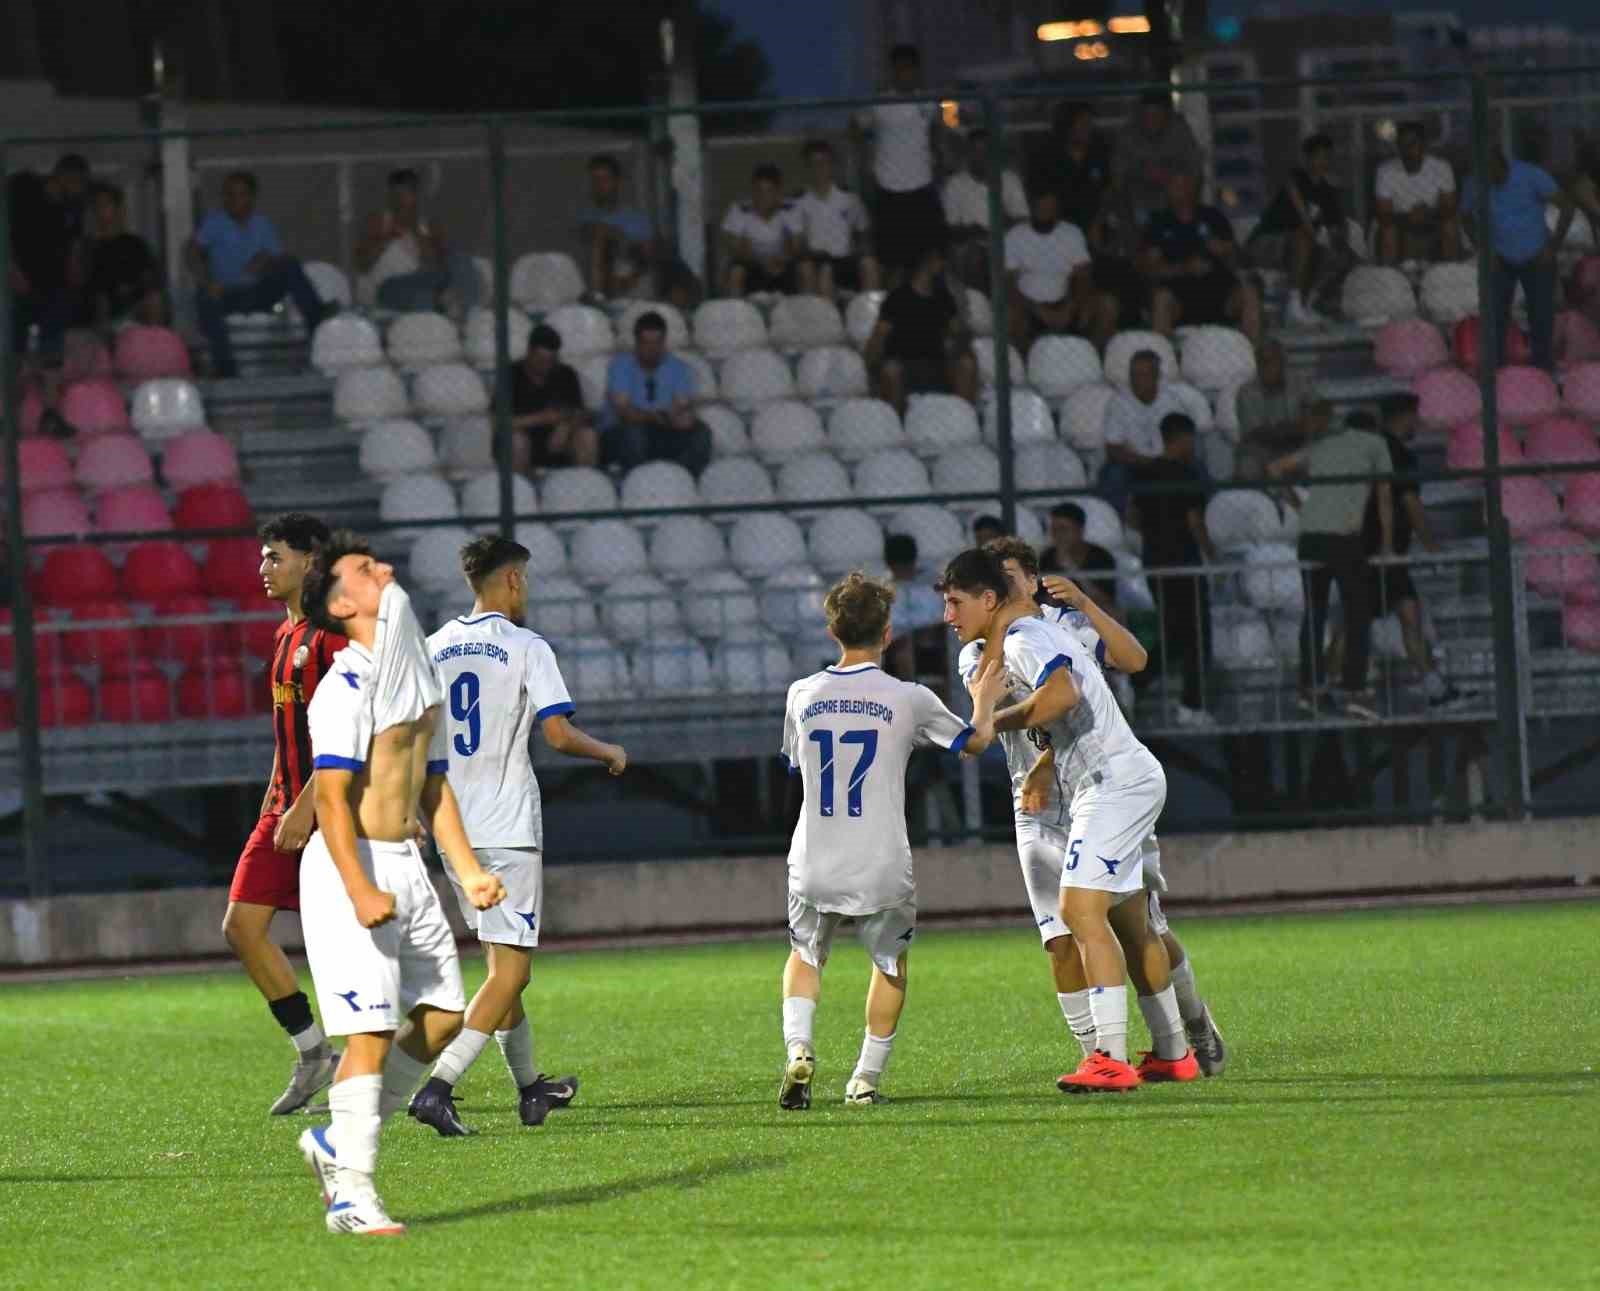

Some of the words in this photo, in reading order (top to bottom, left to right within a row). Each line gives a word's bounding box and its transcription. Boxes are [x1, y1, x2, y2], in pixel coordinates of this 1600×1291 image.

[450, 671, 481, 757] 9
[809, 729, 878, 817] 17
[1066, 839, 1083, 871] 5
